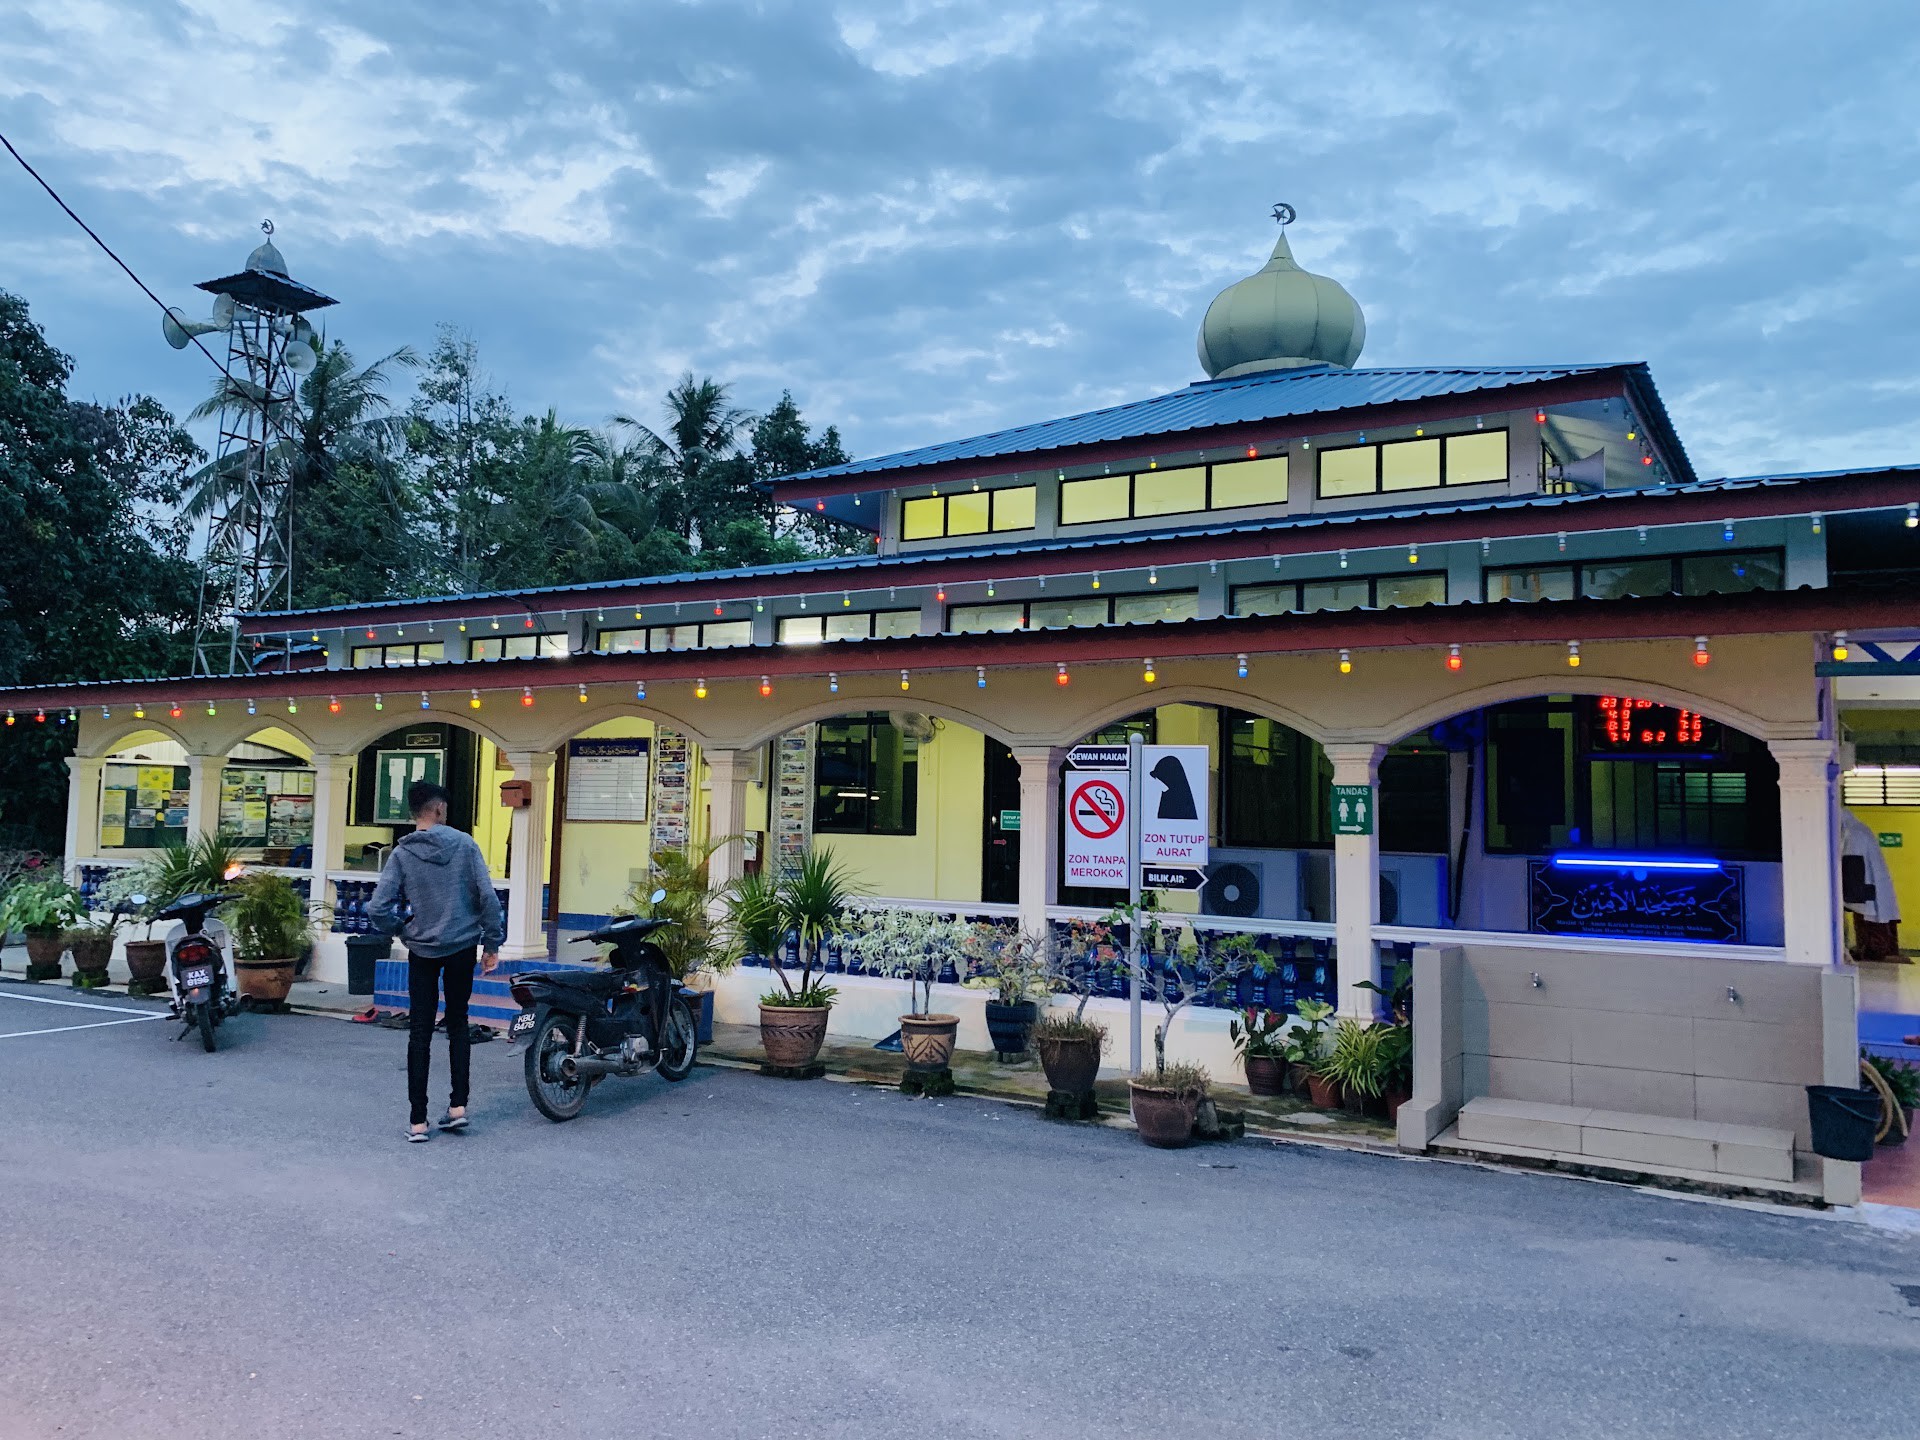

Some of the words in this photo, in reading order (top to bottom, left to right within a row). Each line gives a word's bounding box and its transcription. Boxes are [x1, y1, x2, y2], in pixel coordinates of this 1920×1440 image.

[1071, 753, 1099, 761] DEWAN
[1100, 753, 1128, 762] MAKAN
[1336, 787, 1368, 796] TANDAS
[1144, 833, 1166, 843] ZON
[1169, 835, 1205, 844] TUTUP
[1156, 848, 1192, 857] AURAT
[1068, 855, 1089, 864] ZON
[1092, 856, 1126, 865] TANPA
[1071, 868, 1123, 878] MEROKOK
[1148, 874, 1169, 883] BILIK
[1169, 875, 1185, 884] AIR
[188, 969, 206, 979] KAX
[518, 1013, 535, 1023] KBU
